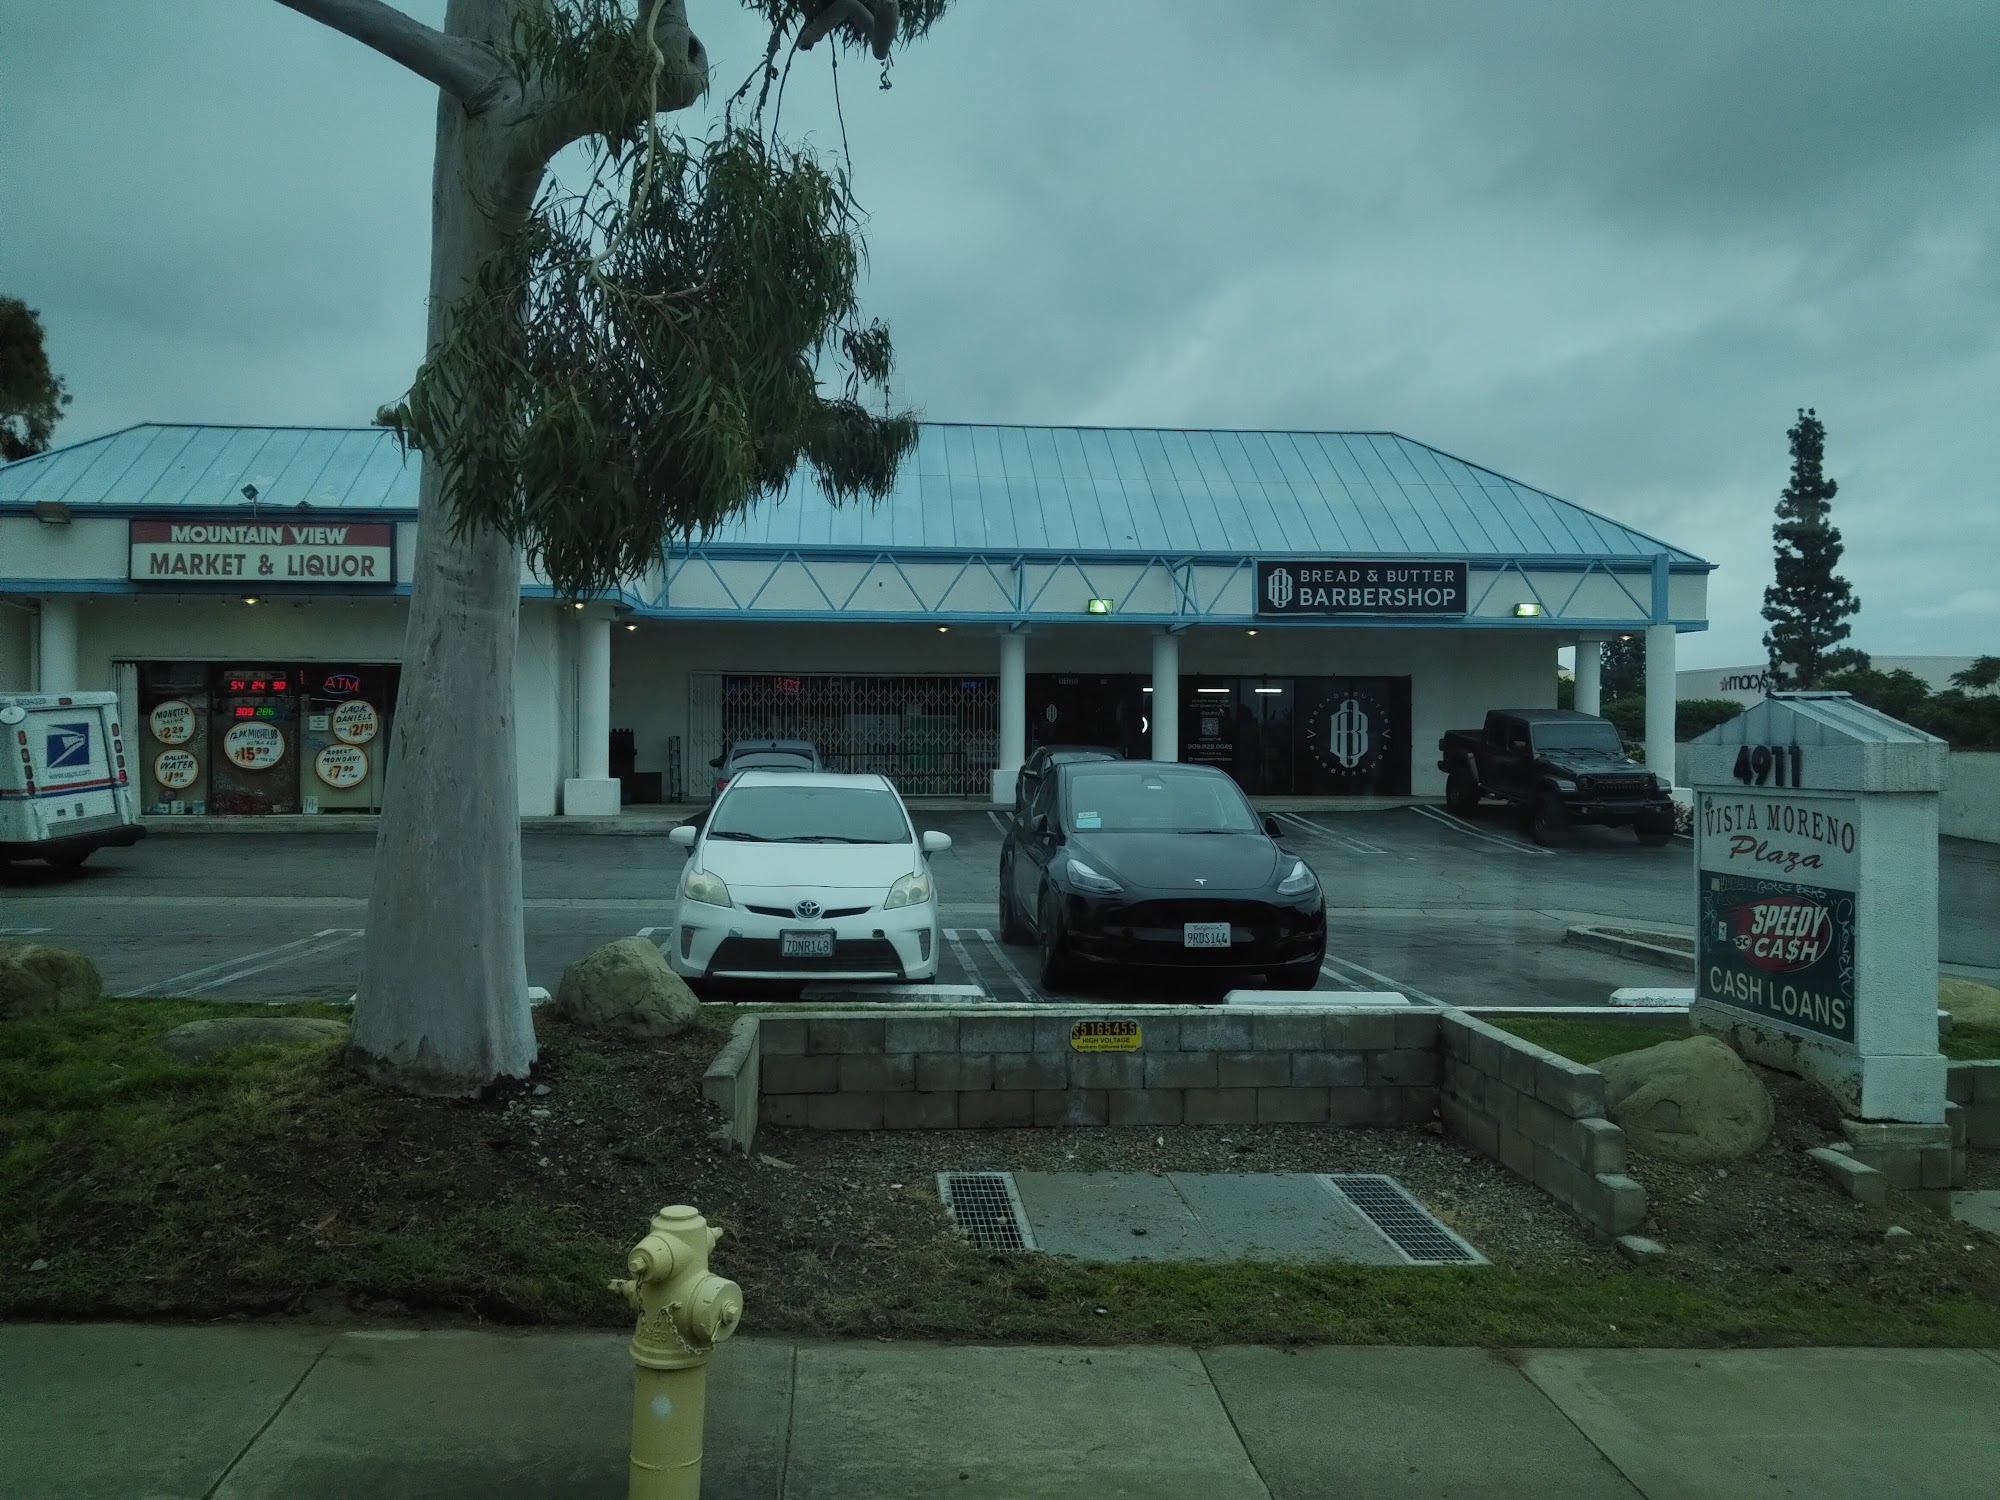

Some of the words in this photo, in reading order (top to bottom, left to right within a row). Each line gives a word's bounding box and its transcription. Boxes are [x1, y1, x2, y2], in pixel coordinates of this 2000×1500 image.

[171, 524, 284, 545] MOUNTAIN
[287, 525, 350, 545] VIEW
[150, 552, 246, 576] MARKET
[257, 553, 274, 576] &
[287, 554, 375, 577] LIQUOR
[1300, 569, 1361, 583] BREAD
[1366, 569, 1379, 583] &
[1387, 569, 1455, 583] BUTTER
[1299, 587, 1456, 607] BARBERSHOP
[251, 680, 266, 690] 24
[324, 676, 360, 692] ATM
[1728, 669, 1769, 693] macy's
[154, 707, 190, 721] MONSTER
[255, 707, 275, 716] 286
[340, 704, 367, 714] JACK
[335, 713, 372, 724] DANIELS
[247, 728, 278, 739] MICHELOB
[160, 760, 194, 770] WATER
[322, 755, 361, 764] MONDAVI
[1733, 745, 1803, 787] 4911
[1705, 803, 1758, 837] VISTA
[1766, 804, 1855, 854] MORENO
[1729, 834, 1824, 873] Plaza
[1751, 905, 1828, 938] SPEEDY
[1187, 932, 1228, 944] 9RDS144
[1736, 938, 1749, 947] SC
[785, 940, 829, 953] 7DNR148
[1710, 965, 1763, 1006] CASH
[1769, 981, 1846, 1030] LOANS
[1100, 1036, 1131, 1044] VOLTAGE
